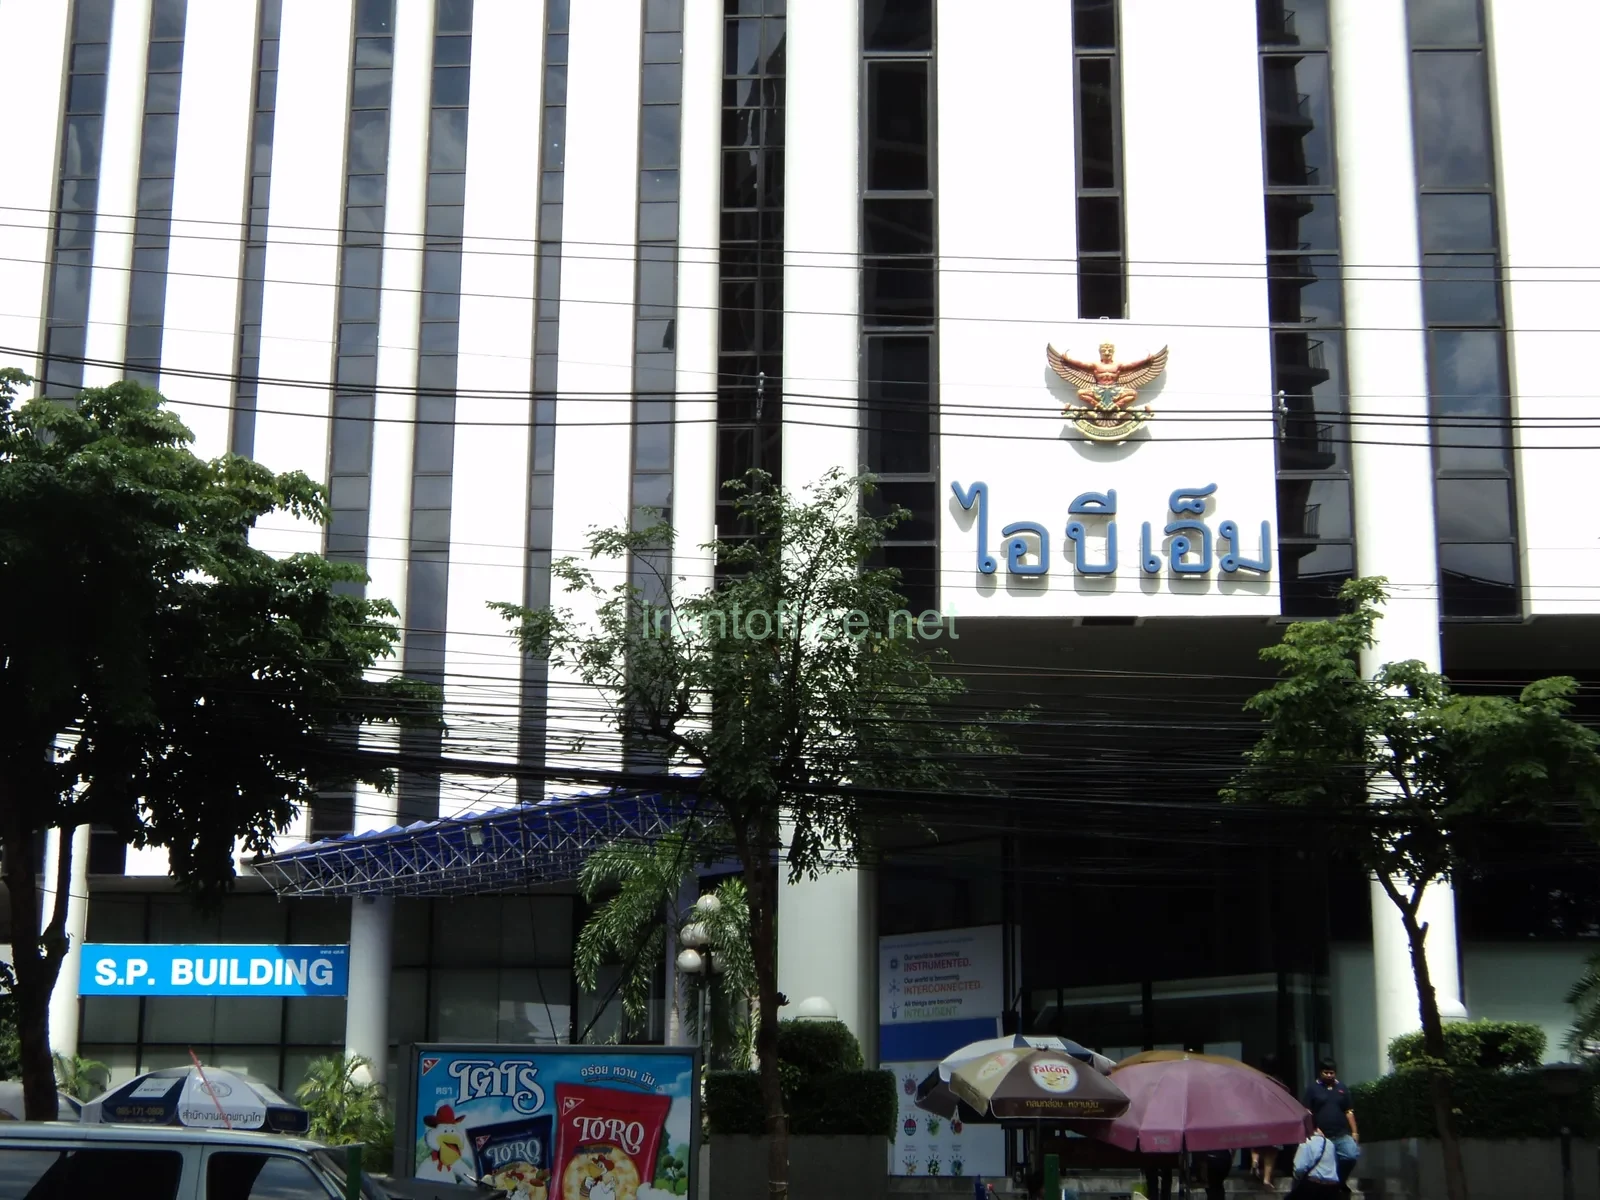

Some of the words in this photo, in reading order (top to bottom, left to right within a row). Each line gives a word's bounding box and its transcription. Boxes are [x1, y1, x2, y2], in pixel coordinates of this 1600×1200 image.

[951, 481, 1272, 574] ไอบีเอ็ม
[94, 958, 155, 986] S.P.
[171, 958, 333, 986] BUILDING
[581, 1064, 608, 1076] อร่อย
[613, 1065, 637, 1079] หวาน
[436, 1087, 452, 1095] ตรา
[573, 1116, 644, 1155] TORO
[485, 1139, 541, 1167] TORO
